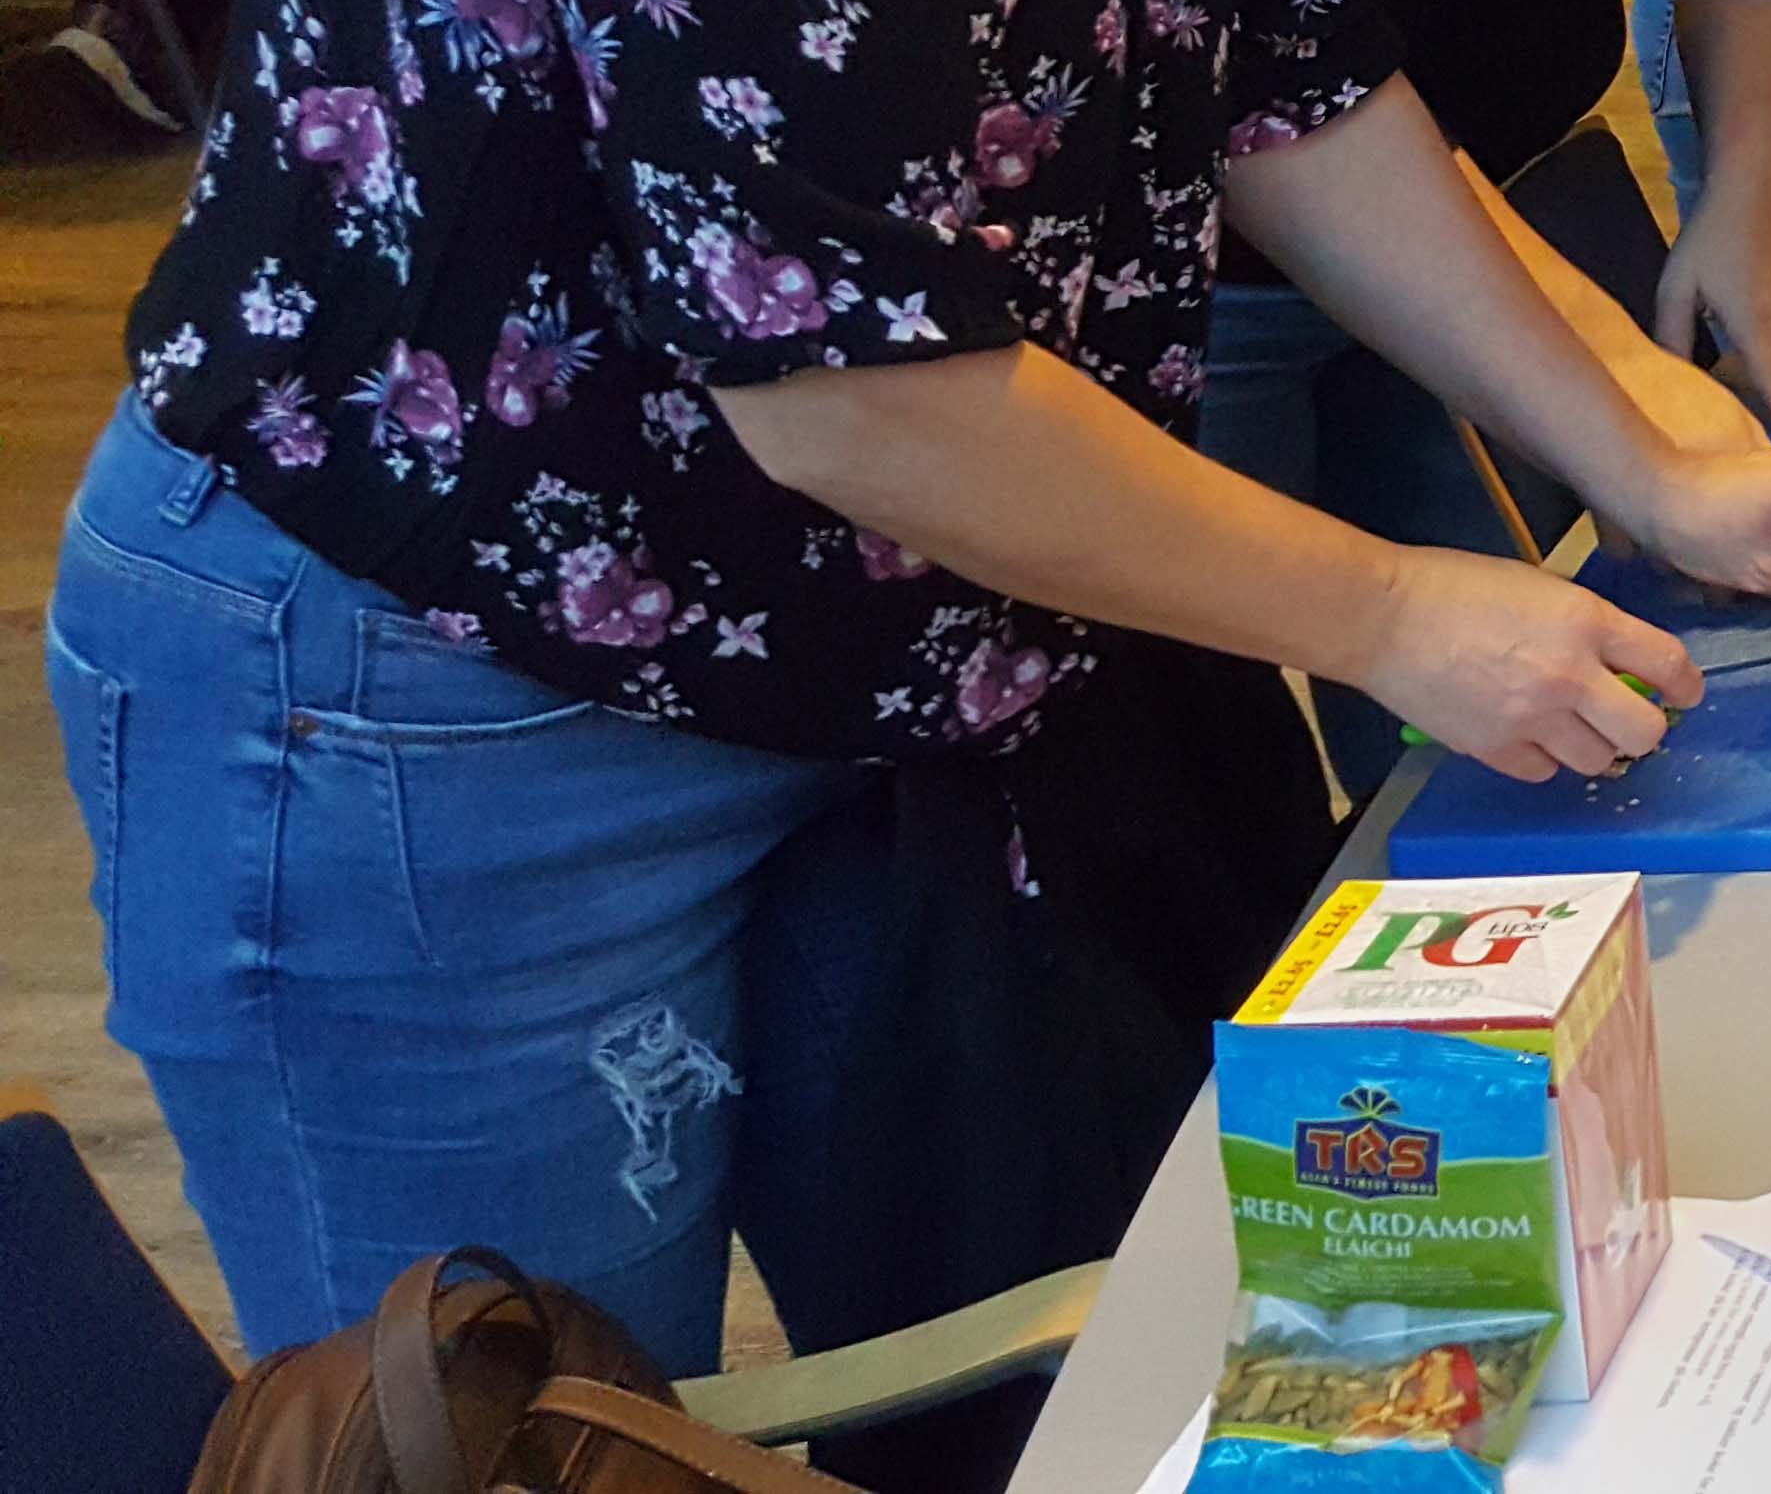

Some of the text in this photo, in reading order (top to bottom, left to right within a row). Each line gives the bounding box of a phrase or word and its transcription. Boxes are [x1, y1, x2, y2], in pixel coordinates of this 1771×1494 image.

[1334, 905, 1544, 972] PG
[1487, 917, 1549, 936] tips
[1305, 1121, 1430, 1179] TRS
[1323, 1207, 1532, 1240] CARDAMOM
[1322, 1235, 1413, 1258] ELAICHI
